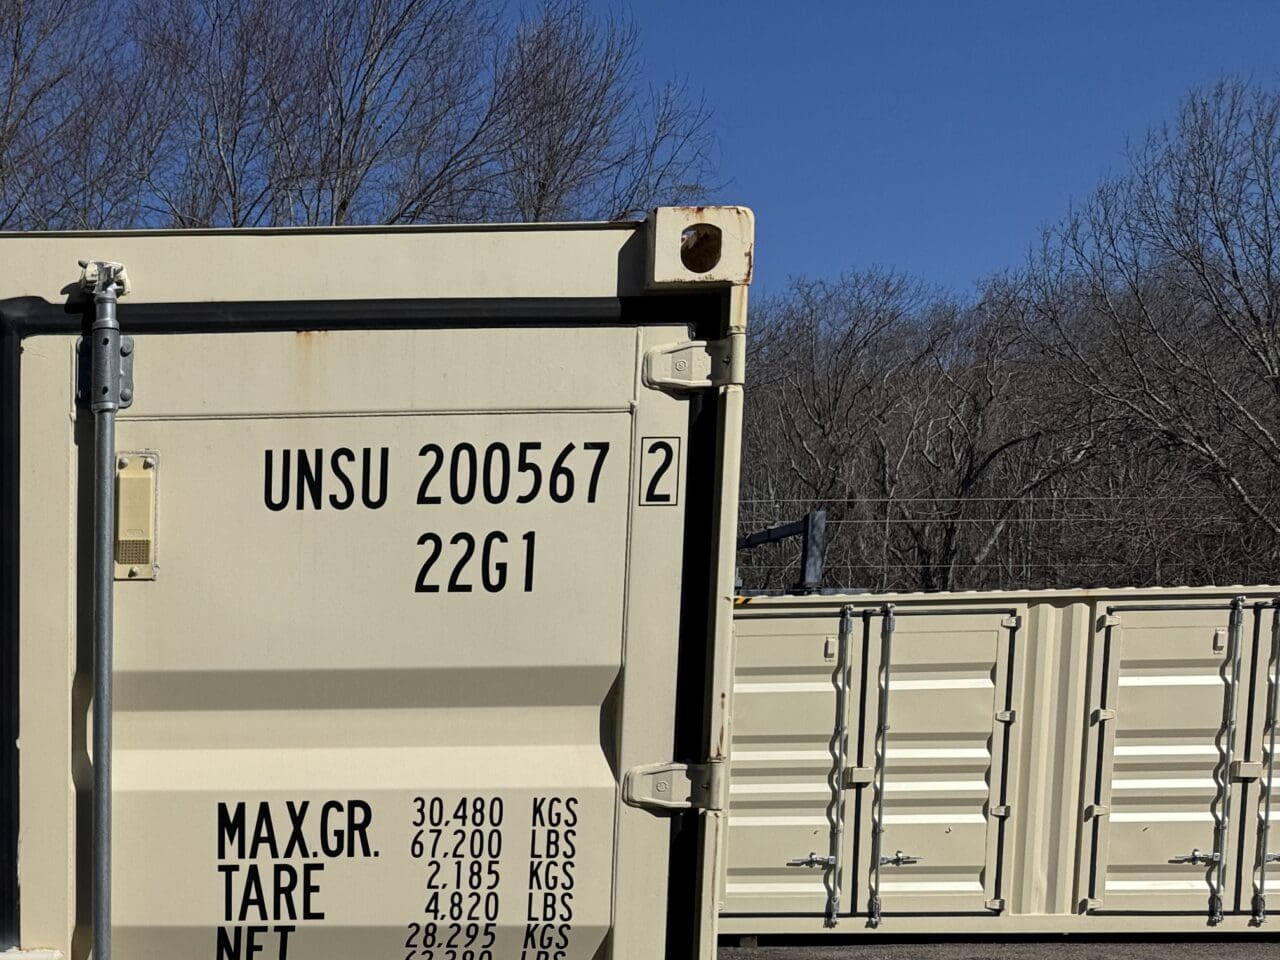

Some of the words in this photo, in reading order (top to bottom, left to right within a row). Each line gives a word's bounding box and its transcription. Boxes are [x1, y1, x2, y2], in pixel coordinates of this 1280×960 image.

[264, 447, 389, 512] UNSU
[416, 441, 610, 505] 200567
[645, 440, 674, 503] 2
[414, 530, 536, 593] 22G1
[217, 799, 379, 860] MAX.GR.
[412, 796, 504, 829] 30,480
[532, 797, 578, 828] KGS
[410, 829, 502, 859] 67,200
[530, 829, 577, 859] LBS
[217, 862, 325, 922] TARE
[426, 860, 500, 890] 2,185
[528, 860, 575, 891] KGS
[424, 891, 499, 922] 4,820
[527, 892, 574, 922] LBS
[404, 922, 497, 949] 28,295
[522, 923, 572, 950] KGS
